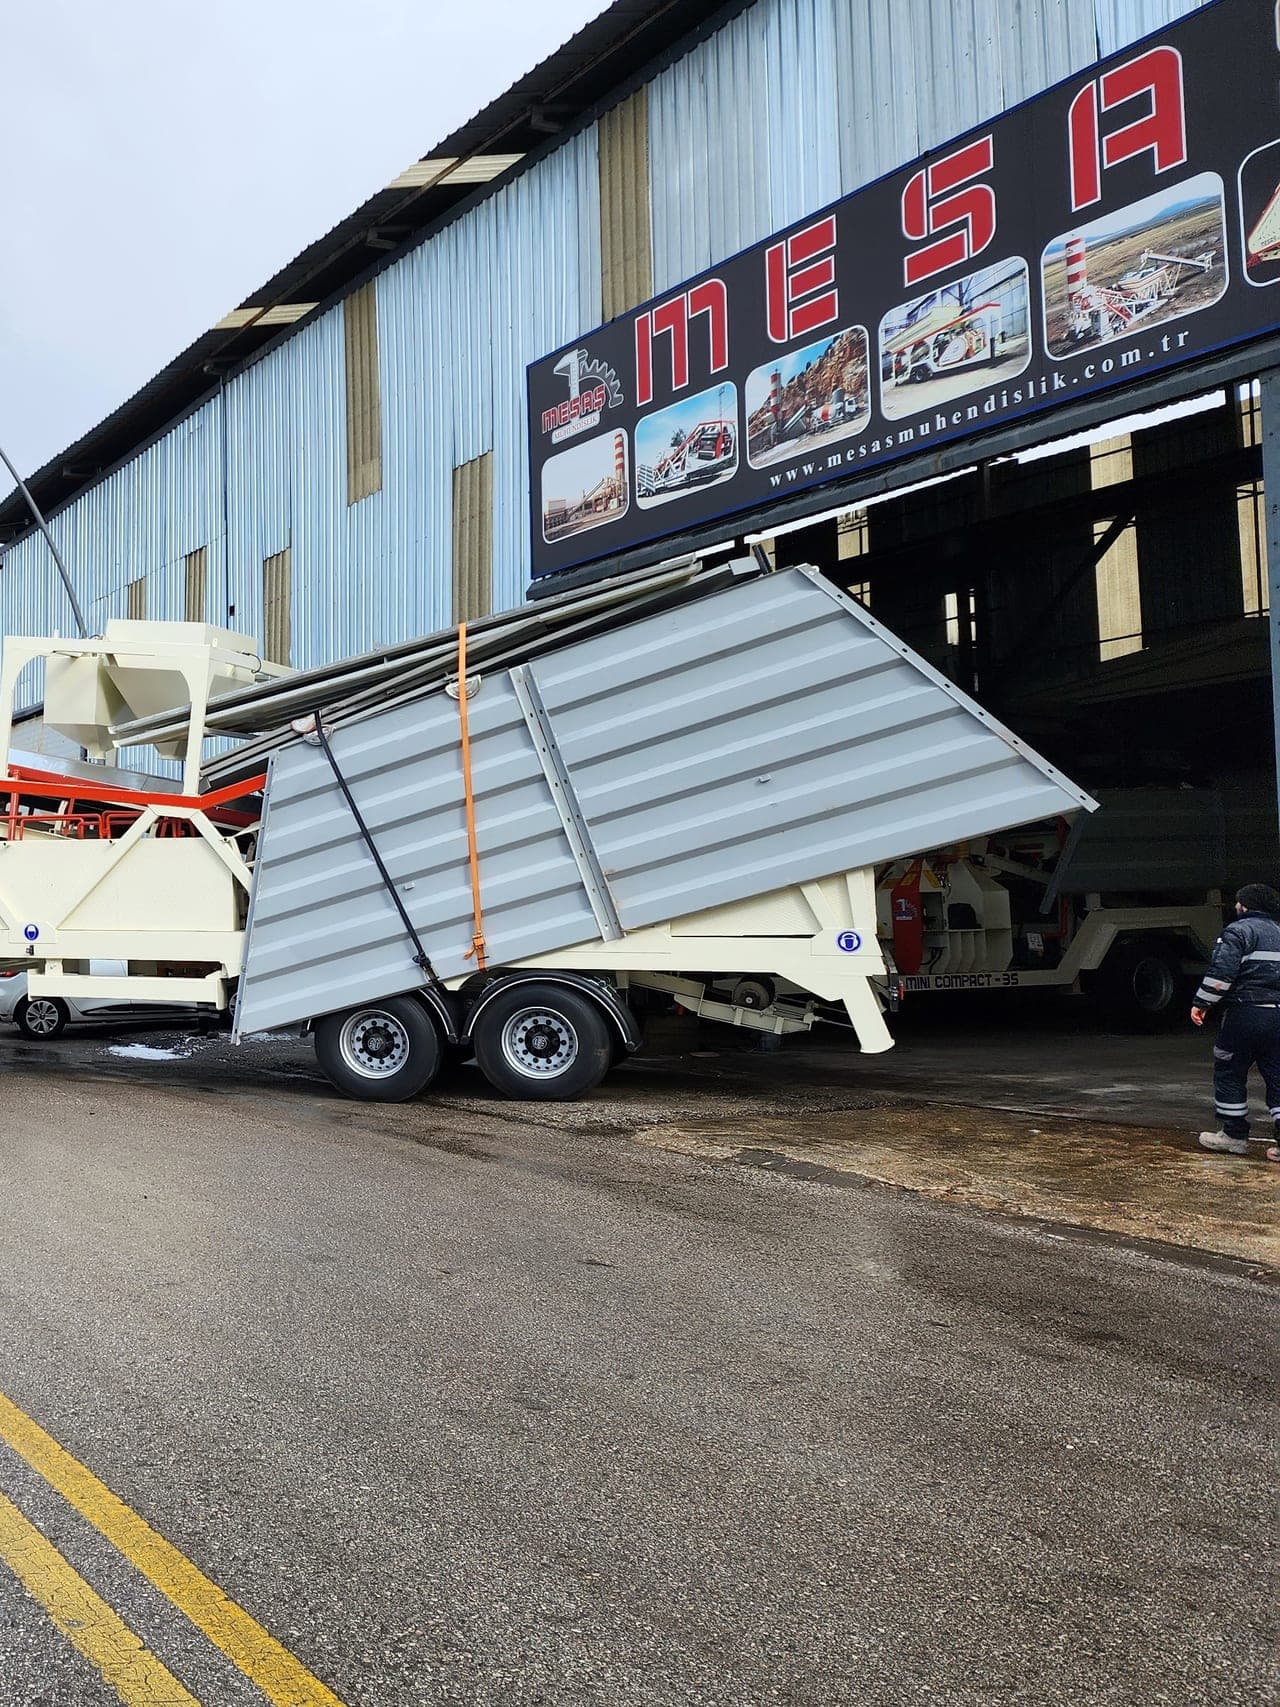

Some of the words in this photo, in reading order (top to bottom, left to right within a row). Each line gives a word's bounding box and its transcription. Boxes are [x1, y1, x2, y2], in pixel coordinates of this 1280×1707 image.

[635, 0, 1280, 407] MESA
[769, 329, 1190, 488] www.mesasmuhendislik.com.tr
[906, 976, 930, 990] MINI
